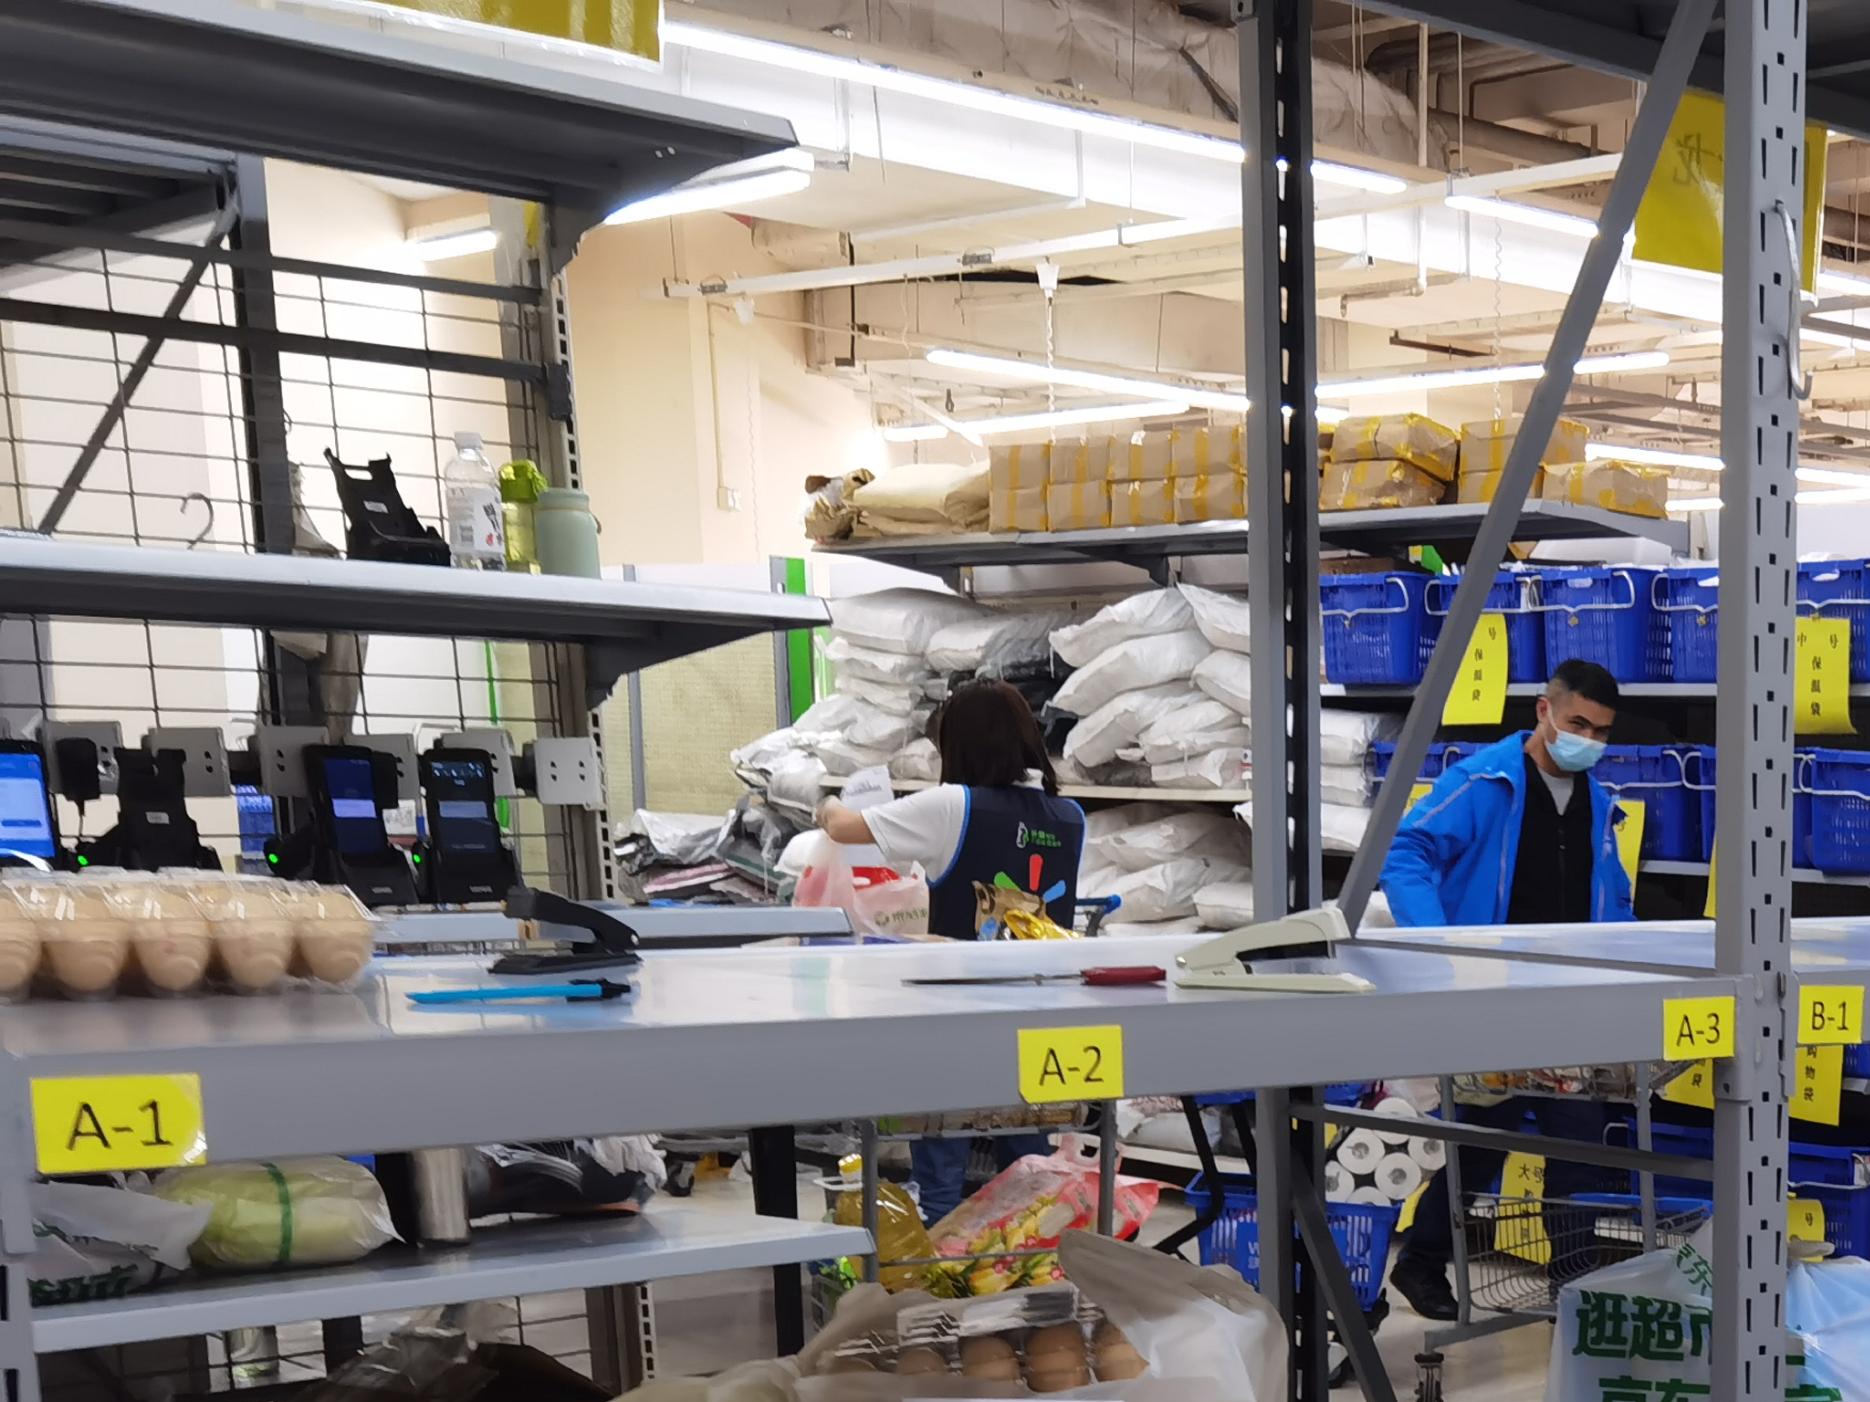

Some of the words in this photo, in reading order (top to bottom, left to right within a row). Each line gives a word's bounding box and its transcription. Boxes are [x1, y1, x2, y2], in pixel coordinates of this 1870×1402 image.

[1676, 1012, 1721, 1047] A-3
[1810, 1000, 1850, 1032] B-1
[1038, 1045, 1104, 1087] A-2
[65, 1099, 174, 1152] A-1
